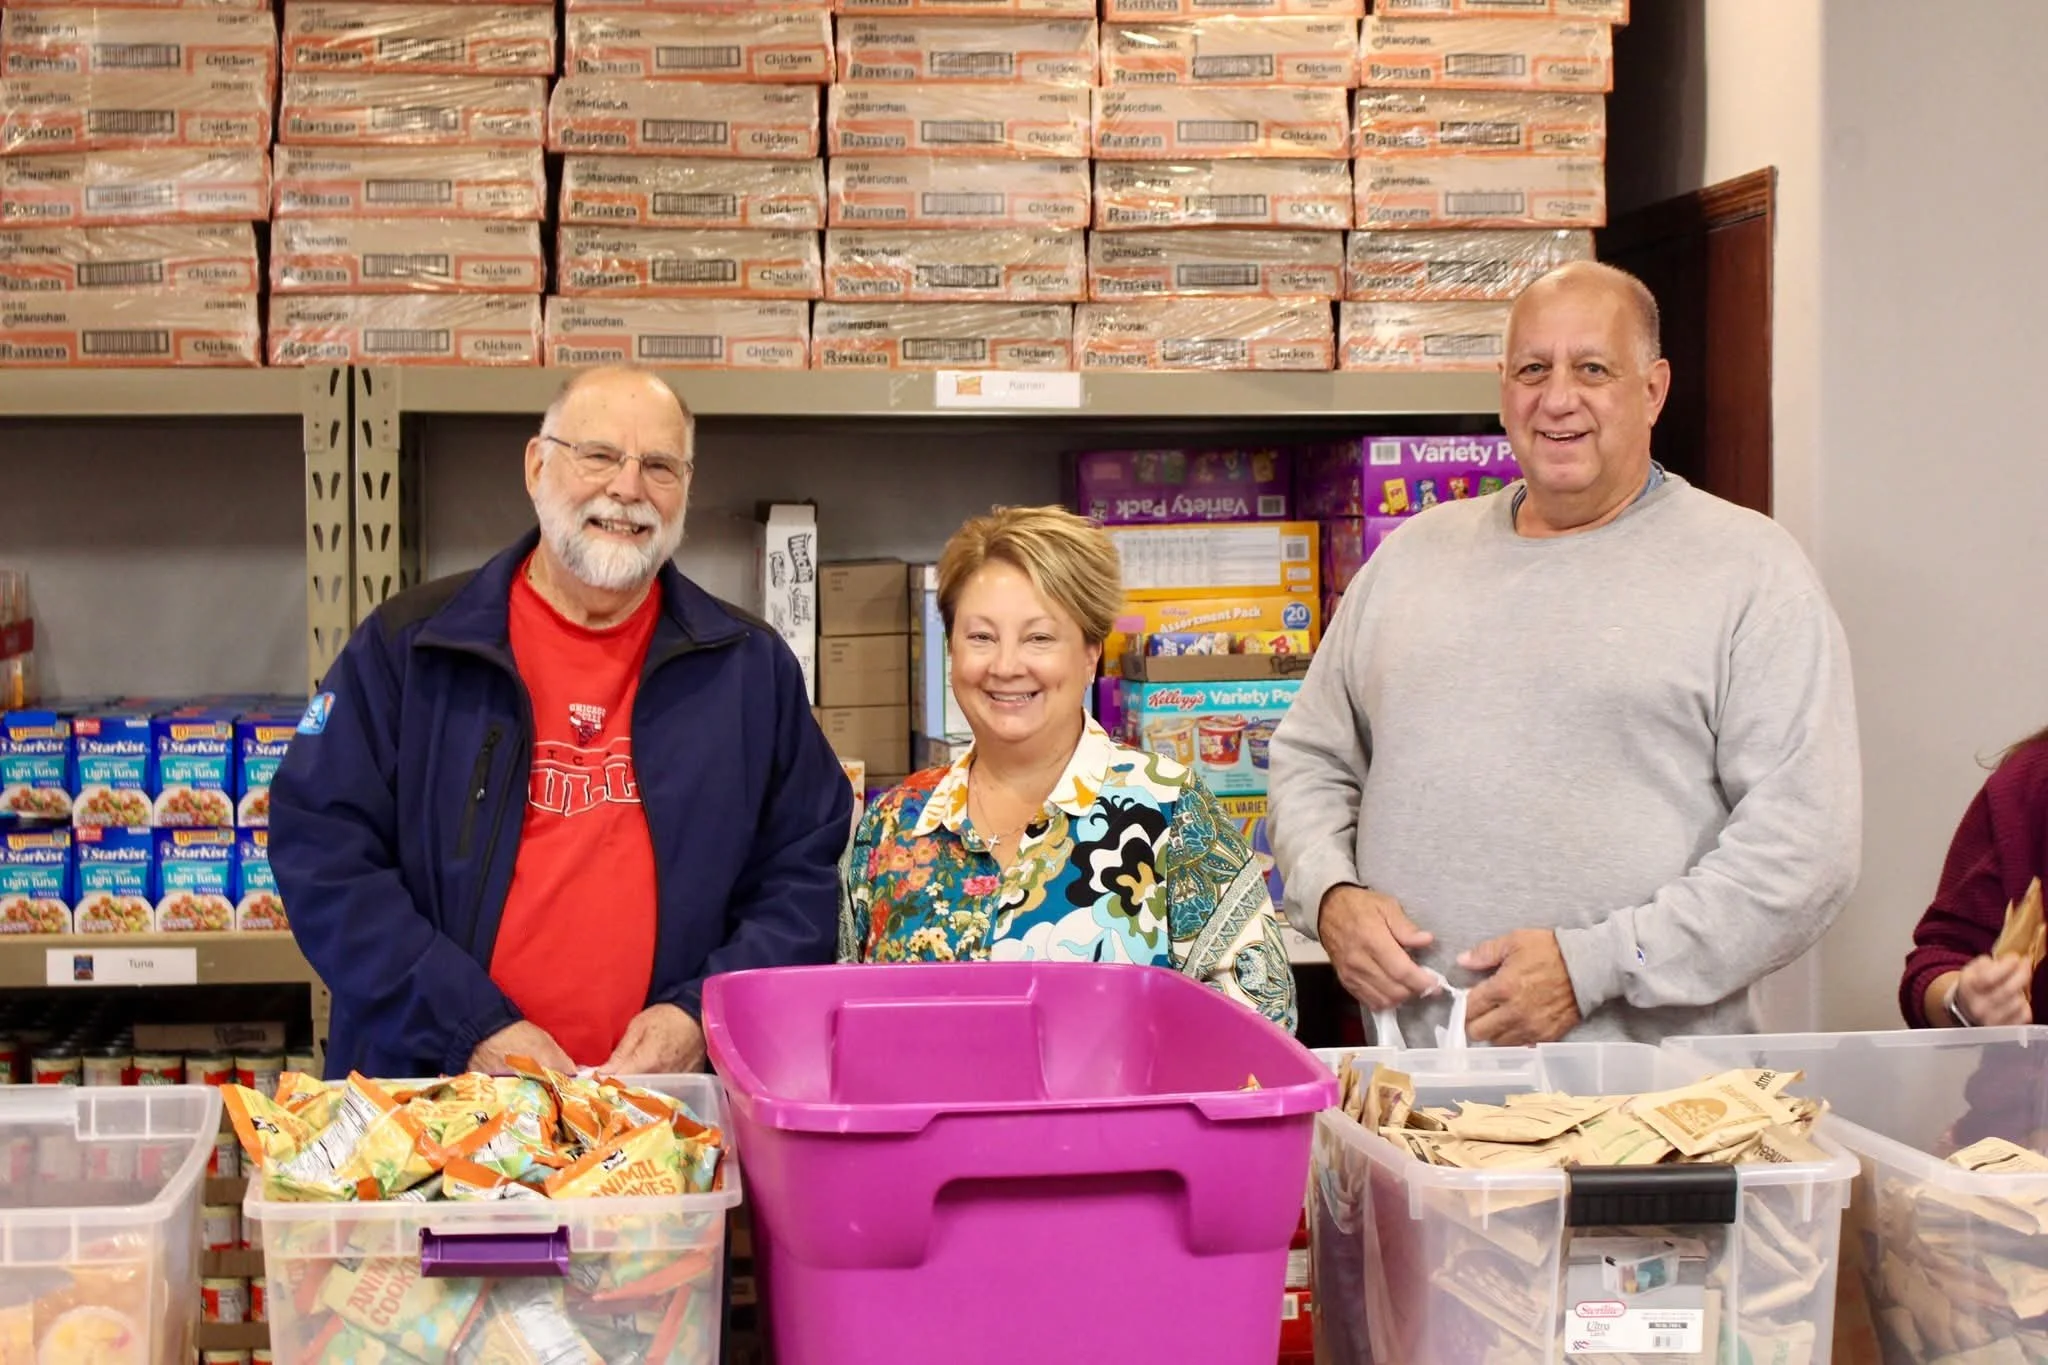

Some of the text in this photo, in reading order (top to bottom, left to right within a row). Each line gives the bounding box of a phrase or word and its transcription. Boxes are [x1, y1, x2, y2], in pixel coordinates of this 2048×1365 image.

[206, 55, 255, 66] Chicken
[764, 54, 812, 65] Chicken
[851, 64, 914, 79] Ramen
[1296, 63, 1342, 74] Chicken
[1115, 69, 1176, 83] Ramen
[751, 133, 798, 145] Chicken
[841, 132, 905, 148] Ramen
[1100, 133, 1162, 148] Ramen
[1281, 131, 1327, 142] Chicken
[760, 204, 807, 215] Chicken
[842, 204, 906, 220] Ramen
[1028, 203, 1074, 214] Chicken
[188, 268, 237, 279] Chicken
[473, 265, 521, 276] Chicken
[13, 313, 66, 323] Maruchan
[571, 317, 624, 327] Maruchan
[0, 343, 67, 359] Ramen
[474, 340, 522, 351] Chicken
[557, 347, 622, 362] Ramen
[746, 347, 793, 358] Chicken
[1009, 347, 1054, 358] Chicken
[1410, 438, 1493, 466] Variety
[1115, 494, 1249, 520] Variety Pack
[1160, 606, 1261, 633] Assortment Pack
[1286, 606, 1306, 622] 20
[1149, 689, 1205, 710] Kellogg's
[1210, 689, 1269, 707] Variety
[8, 740, 64, 754] StarKist
[89, 740, 145, 754] StarKist
[171, 740, 226, 754] StarKist
[6, 767, 59, 780] Light Tuna
[85, 767, 139, 780] Light Tuna
[166, 767, 220, 780] Light Tuna
[251, 769, 273, 782] Ligh
[8, 849, 63, 863] StarKist
[92, 848, 147, 861] StarKist
[173, 846, 227, 859] StarKist
[3, 877, 57, 890] Light Tuna
[86, 875, 140, 887] Light Tuna
[168, 872, 222, 885] Light Tuna
[128, 958, 154, 969] Tuna
